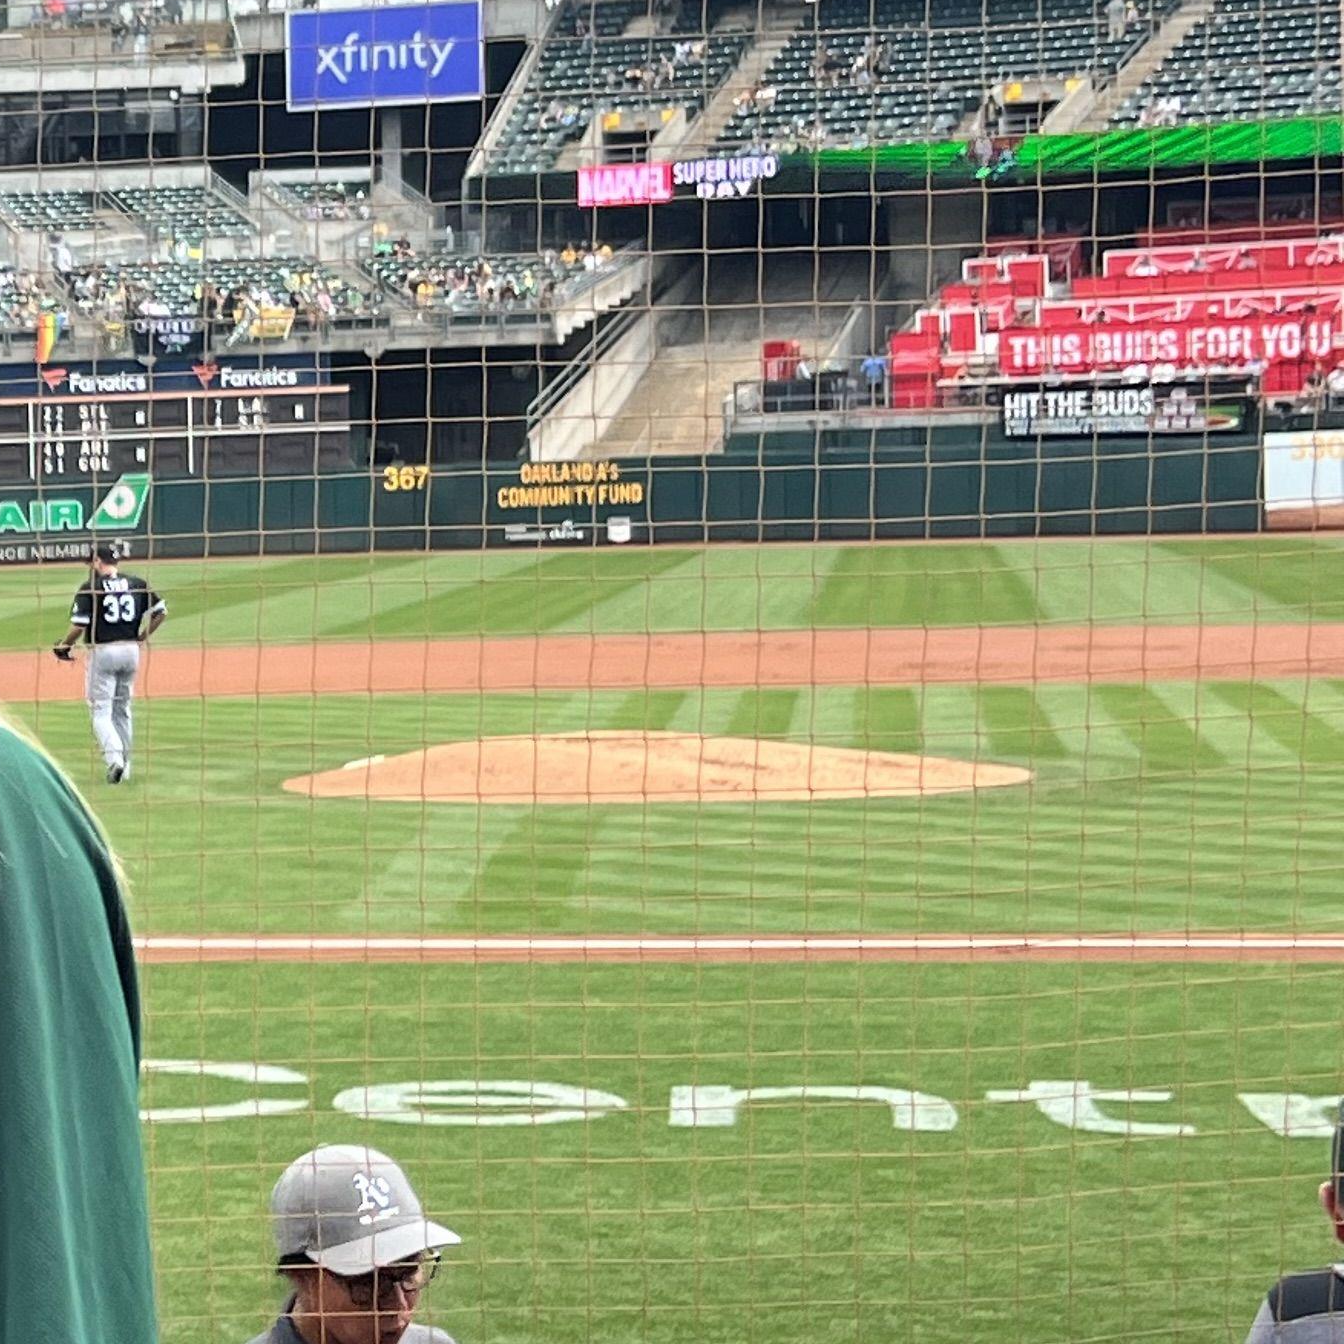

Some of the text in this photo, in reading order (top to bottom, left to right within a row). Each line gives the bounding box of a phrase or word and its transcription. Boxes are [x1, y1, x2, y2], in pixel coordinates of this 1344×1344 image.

[316, 31, 457, 84] xfinity
[579, 166, 672, 204] MARVEL
[1009, 335, 1081, 367] THIS
[1262, 321, 1332, 358] YOU
[69, 370, 147, 394] Fanatics
[220, 365, 298, 388] Fanatics
[1004, 388, 1153, 419] HIT THE BUDS
[383, 466, 429, 491] 367
[519, 462, 594, 484] OAKLAND
[598, 482, 644, 505] FUND
[31, 542, 96, 560] MEMBE
[103, 594, 136, 623] 33
